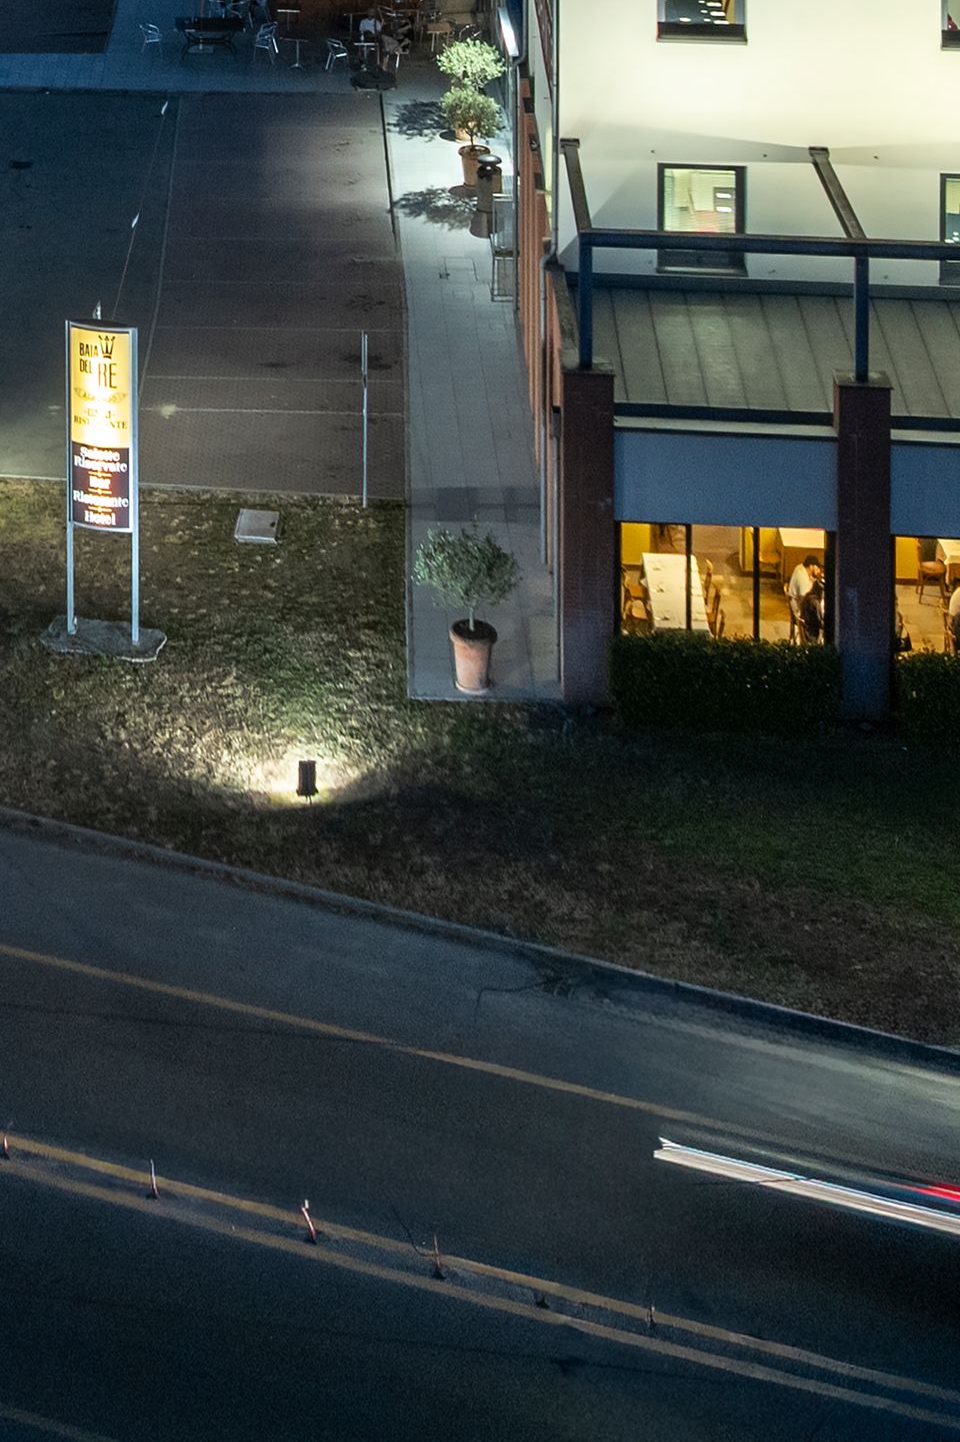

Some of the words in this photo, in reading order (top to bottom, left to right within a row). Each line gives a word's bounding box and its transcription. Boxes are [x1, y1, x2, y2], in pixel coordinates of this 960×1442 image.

[79, 341, 99, 358] BAIA
[79, 358, 92, 374] DEL
[97, 362, 118, 389] RE
